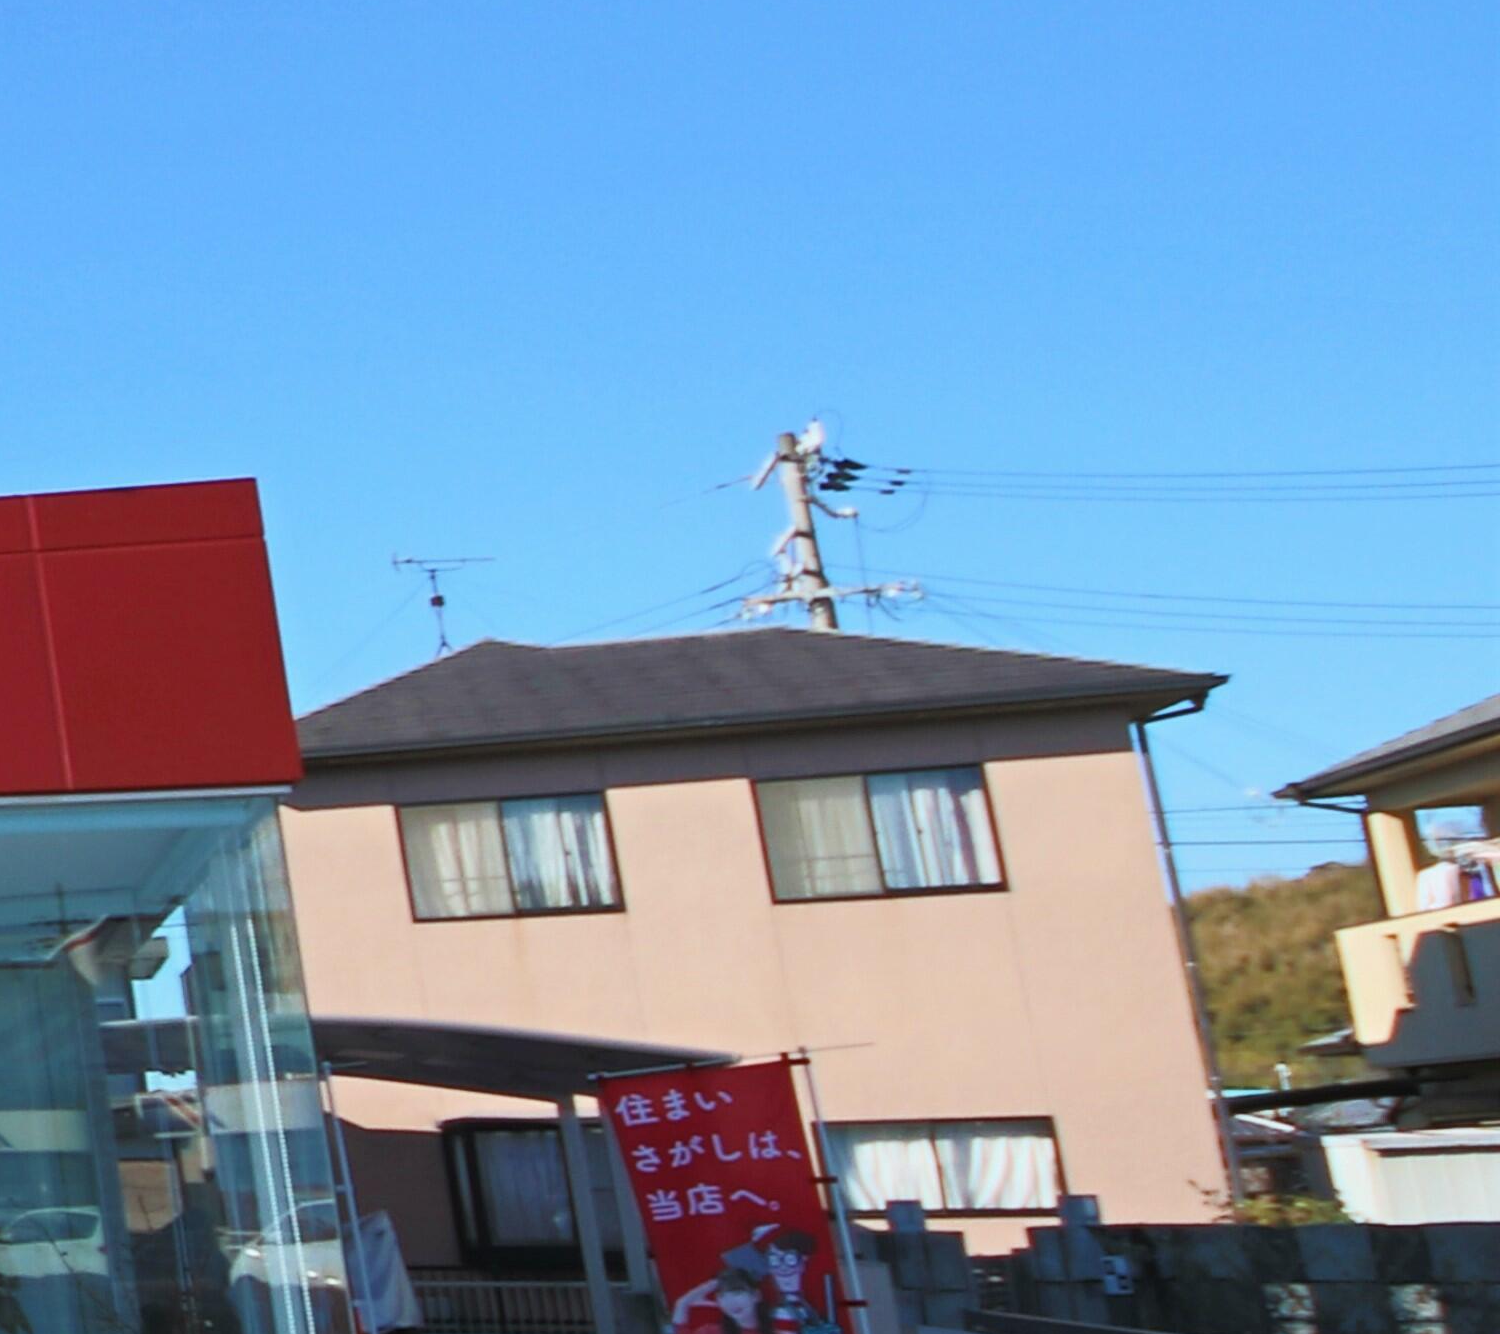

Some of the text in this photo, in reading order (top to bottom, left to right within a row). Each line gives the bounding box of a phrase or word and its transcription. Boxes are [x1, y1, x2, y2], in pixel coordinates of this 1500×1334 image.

[615, 1087, 733, 1128] 住まい
[631, 1132, 802, 1174] さがしは、
[646, 1182, 781, 1223] 当店へ。
